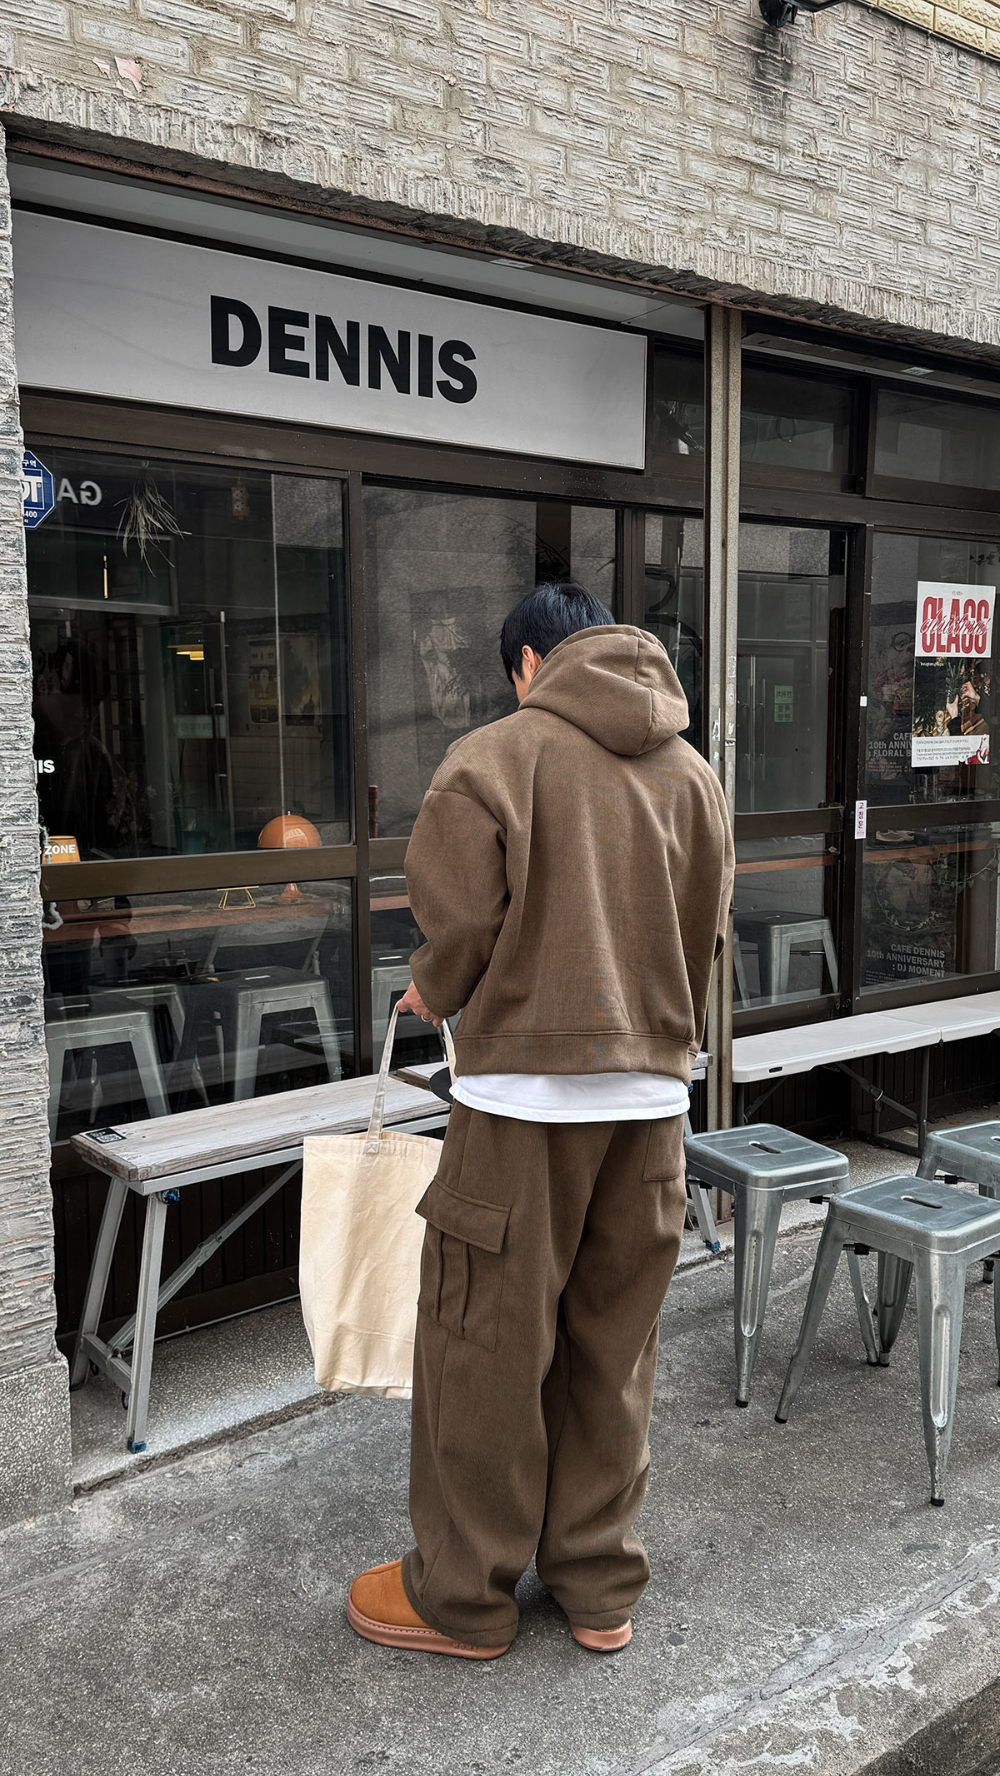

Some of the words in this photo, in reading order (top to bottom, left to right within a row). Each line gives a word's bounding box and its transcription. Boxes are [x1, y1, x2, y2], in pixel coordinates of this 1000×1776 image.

[210, 295, 477, 404] DENNIS
[873, 749, 904, 757] FLORAL
[44, 844, 76, 855] ZONE
[890, 943, 912, 954] CAFE
[913, 946, 945, 958] DENNIS
[866, 949, 884, 960] 10th
[886, 952, 945, 968] ANNIVERSARY
[897, 963, 907, 972] DJ
[908, 965, 946, 978] MOMENT
